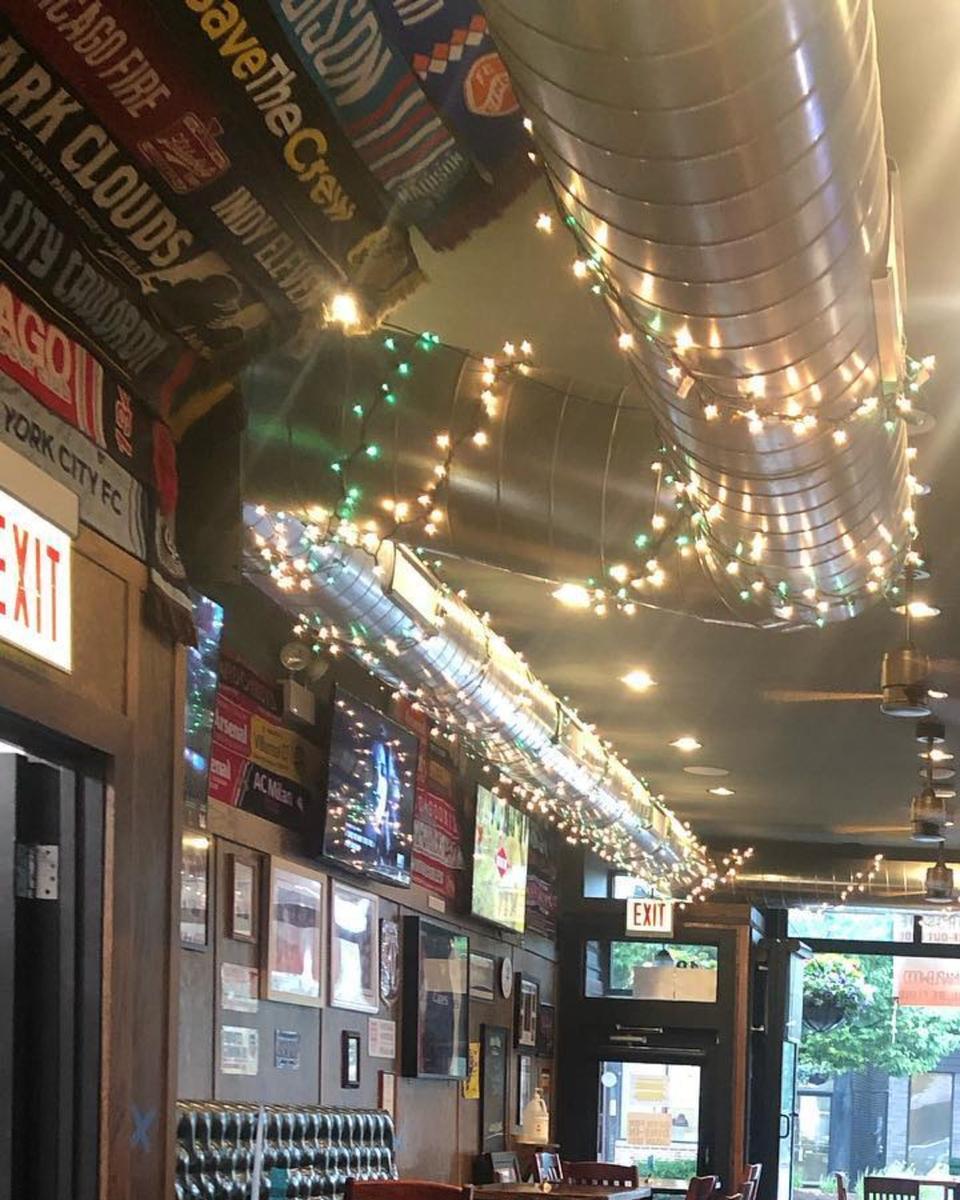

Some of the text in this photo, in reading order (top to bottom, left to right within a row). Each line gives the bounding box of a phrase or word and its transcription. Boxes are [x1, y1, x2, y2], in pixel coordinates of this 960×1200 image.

[98, 46, 172, 119] FIRE
[60, 123, 194, 267] CLOUDS
[210, 185, 278, 246] INDY
[3, 403, 56, 464] YORK
[58, 446, 101, 495] CITY
[102, 480, 123, 517] FC
[0, 515, 61, 643] XIT
[253, 772, 267, 794] AC
[633, 902, 666, 927] EXIT
